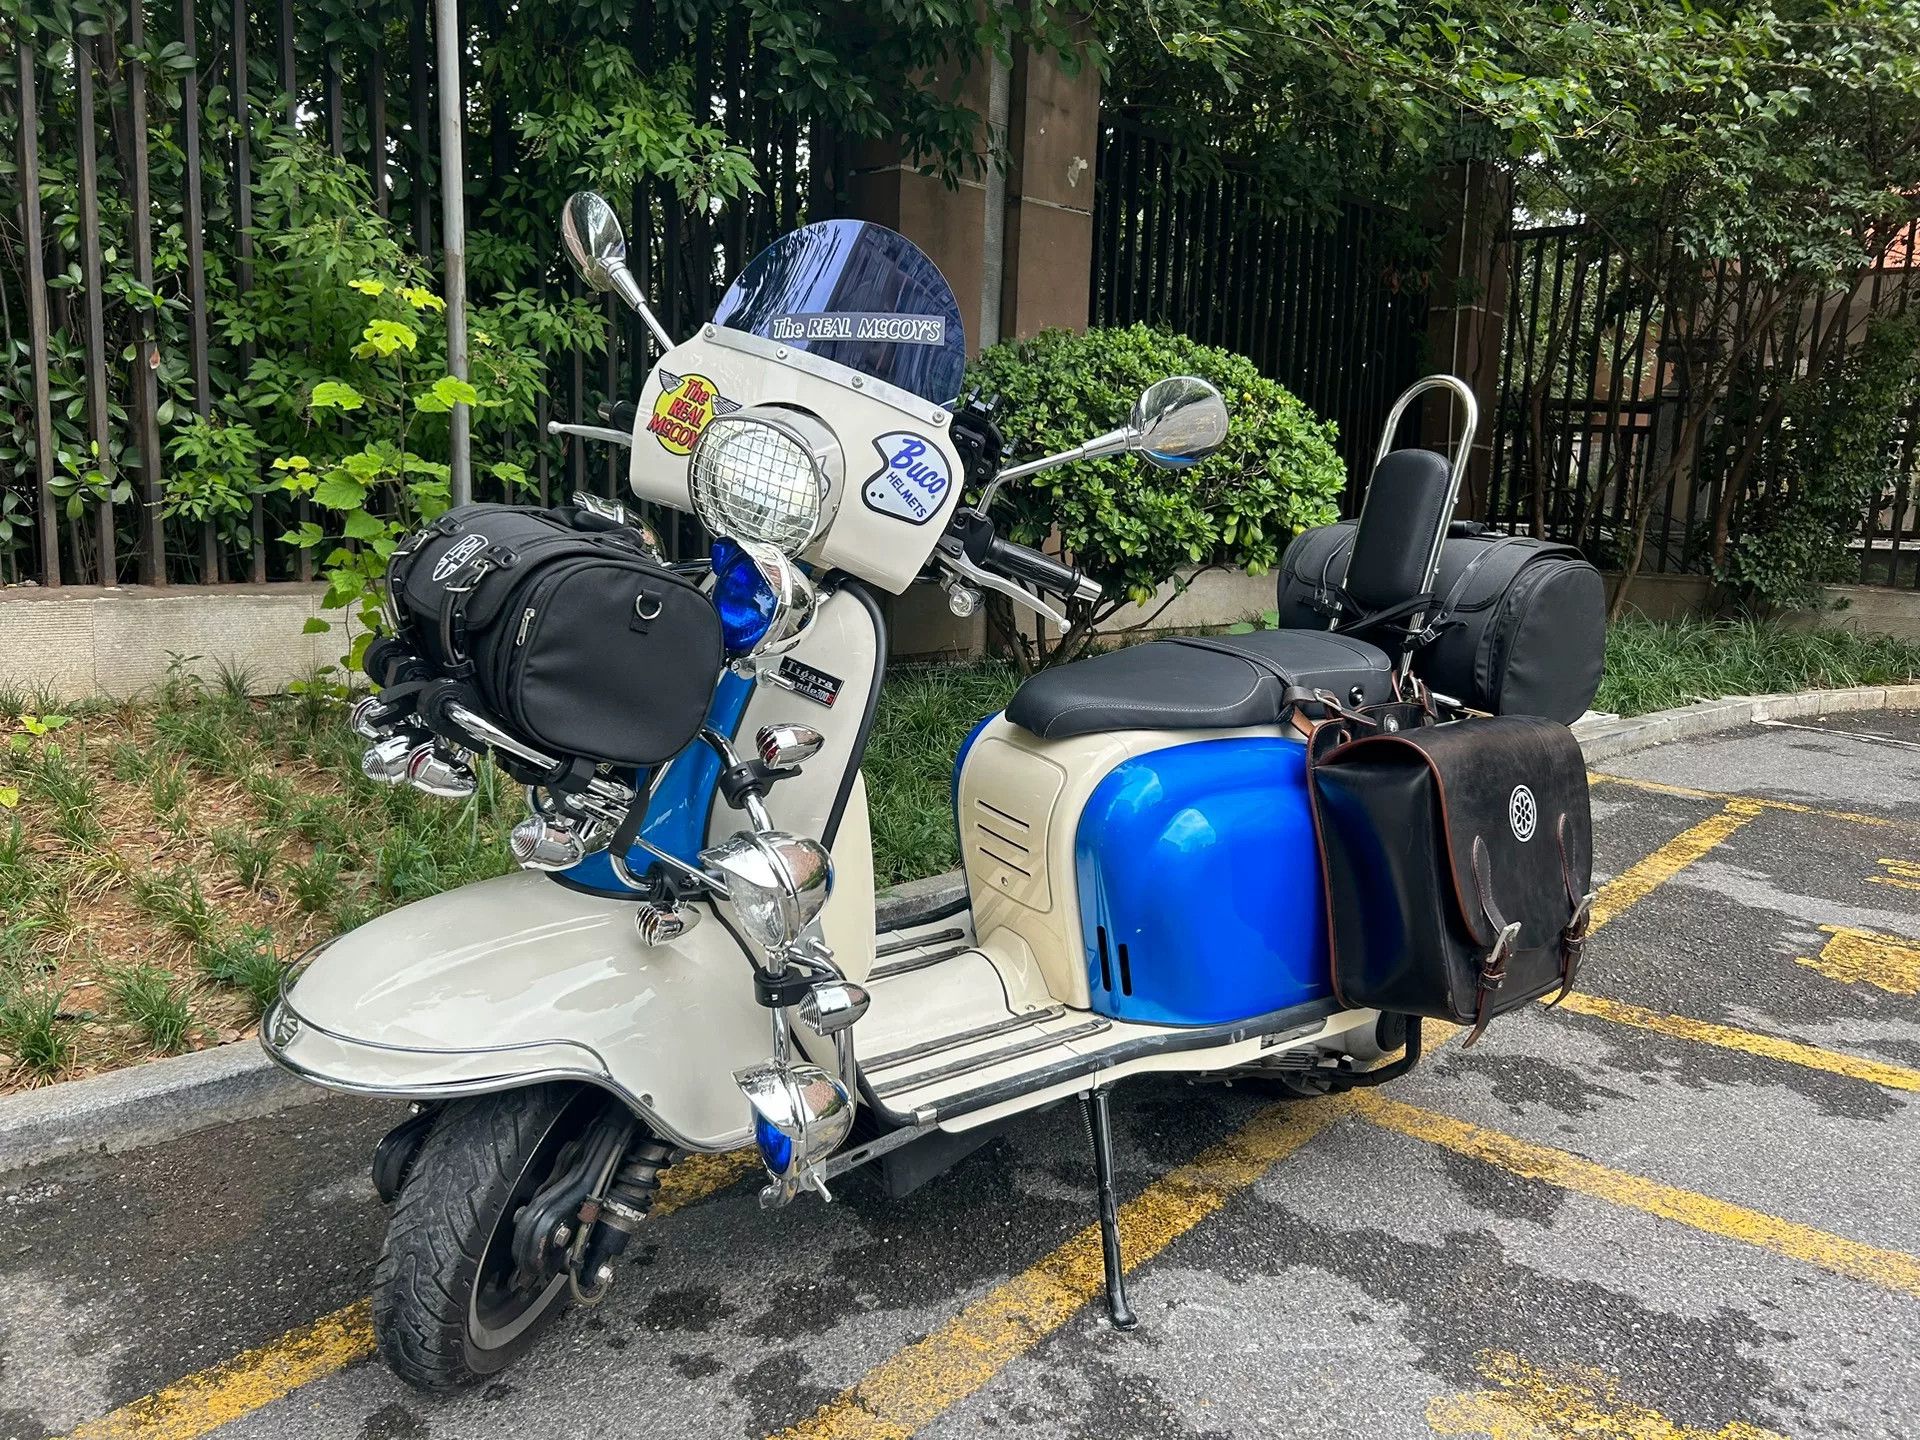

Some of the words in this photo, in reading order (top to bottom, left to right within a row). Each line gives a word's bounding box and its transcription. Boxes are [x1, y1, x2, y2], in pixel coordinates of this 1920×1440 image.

[773, 317, 804, 339] The
[807, 318, 851, 338] REAL
[683, 378, 710, 406] The
[667, 397, 706, 429] REAL
[890, 438, 946, 494] Buco
[886, 471, 927, 518] HELMETS
[788, 660, 833, 690] Tigara
